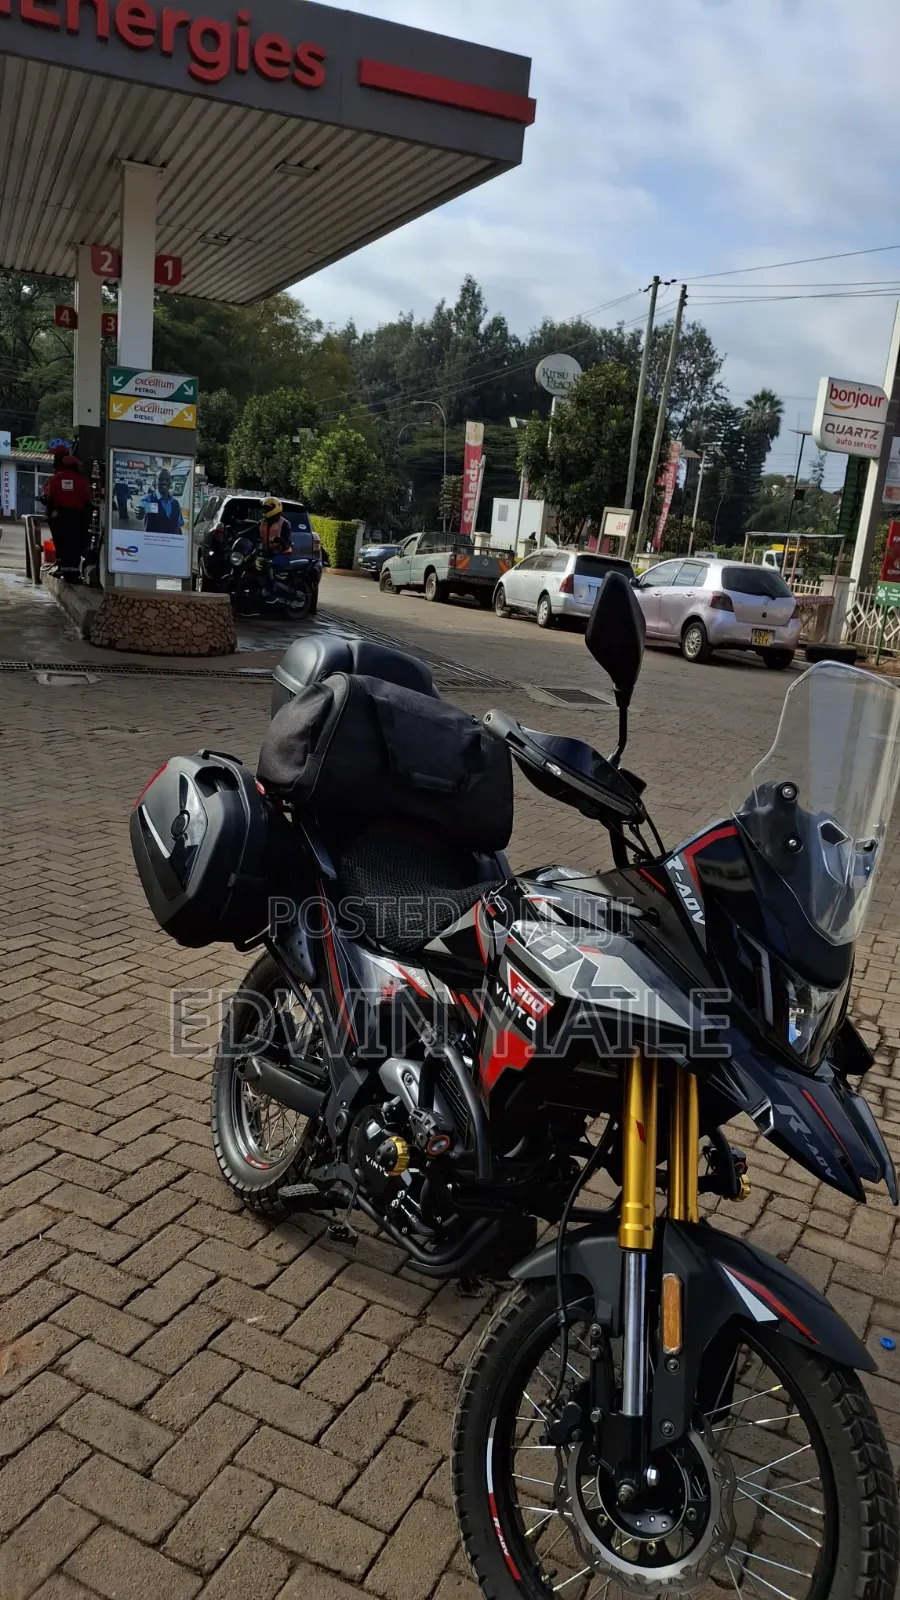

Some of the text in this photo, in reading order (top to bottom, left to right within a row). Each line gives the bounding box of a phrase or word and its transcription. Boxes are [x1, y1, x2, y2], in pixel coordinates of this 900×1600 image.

[100, 251, 114, 273] 2
[163, 260, 173, 281] 1
[60, 309, 71, 325] 4
[106, 316, 116, 332] 3
[134, 377, 174, 390] excellium
[134, 386, 157, 395] PETROL
[829, 383, 885, 409] bonjour
[133, 403, 174, 416] excellium
[133, 413, 155, 421] DIESEL
[824, 422, 879, 441] QUARTZ
[836, 437, 877, 450] auto service
[462, 459, 480, 523] Salads
[616, 519, 627, 530] air
[665, 854, 706, 925] R-ADV
[495, 982, 537, 1031] VINTO
[514, 982, 545, 1014] 300
